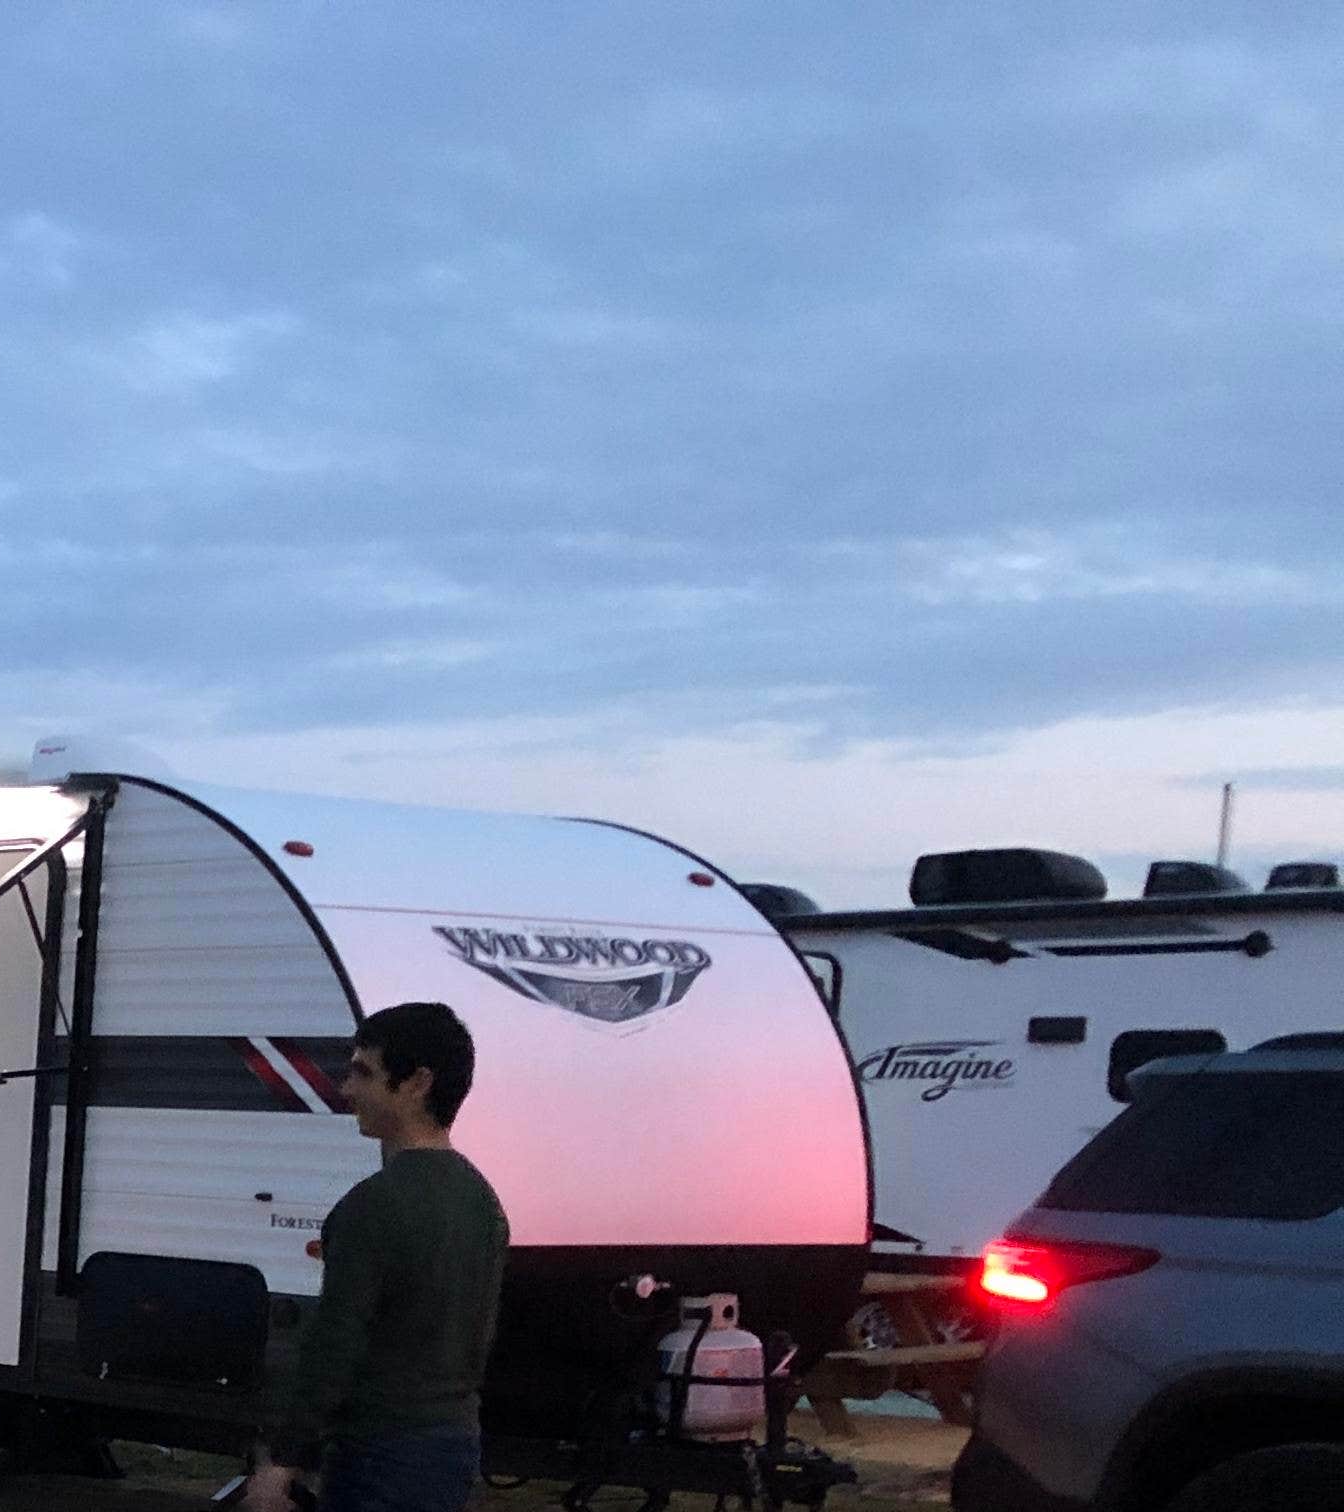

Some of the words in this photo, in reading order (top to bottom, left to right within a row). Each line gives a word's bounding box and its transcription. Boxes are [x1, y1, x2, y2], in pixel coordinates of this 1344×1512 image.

[431, 926, 711, 972] WILDWOOD
[856, 1043, 1018, 1102] Imagine
[271, 1214, 322, 1230] FOREST
